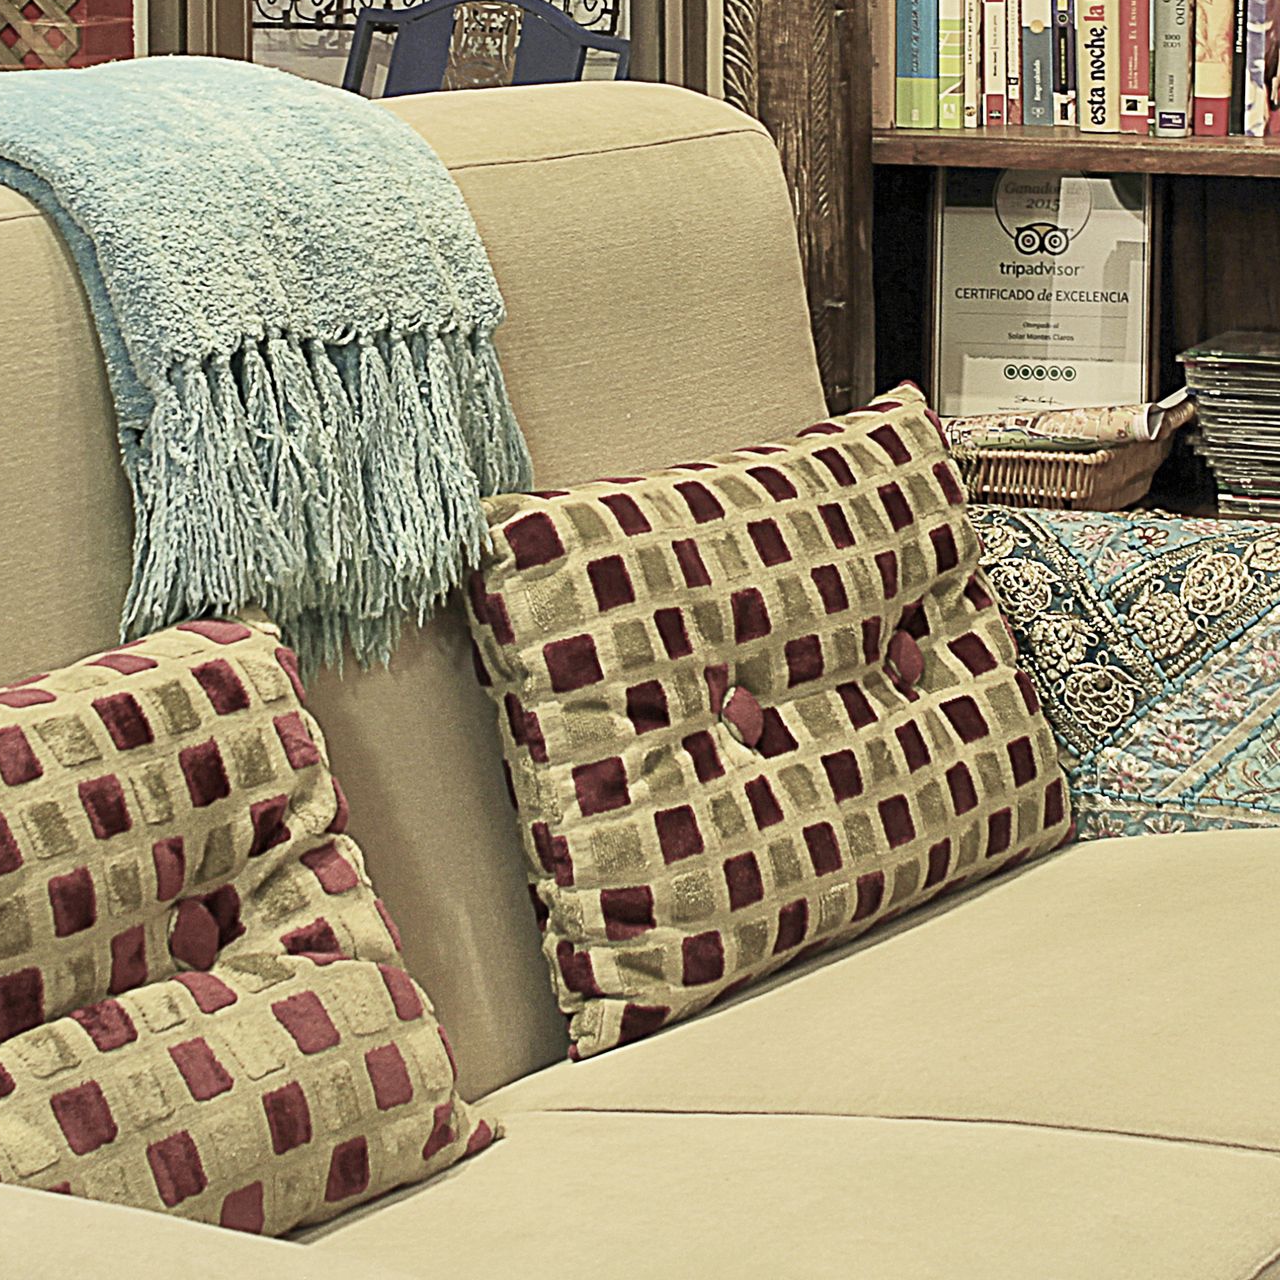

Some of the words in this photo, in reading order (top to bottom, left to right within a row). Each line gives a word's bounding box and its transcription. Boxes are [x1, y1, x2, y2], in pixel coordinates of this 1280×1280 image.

[1083, 5, 1105, 22] la
[1084, 25, 1108, 81] noche,
[1086, 87, 1105, 125] esta
[1026, 198, 1060, 212] 2015
[1000, 262, 1080, 278] tripadvisor
[955, 288, 1034, 301] CERTIFICADO
[1037, 289, 1052, 301] de
[1056, 291, 1130, 303] EXCELENCIA
[1008, 332, 1025, 340] Solar
